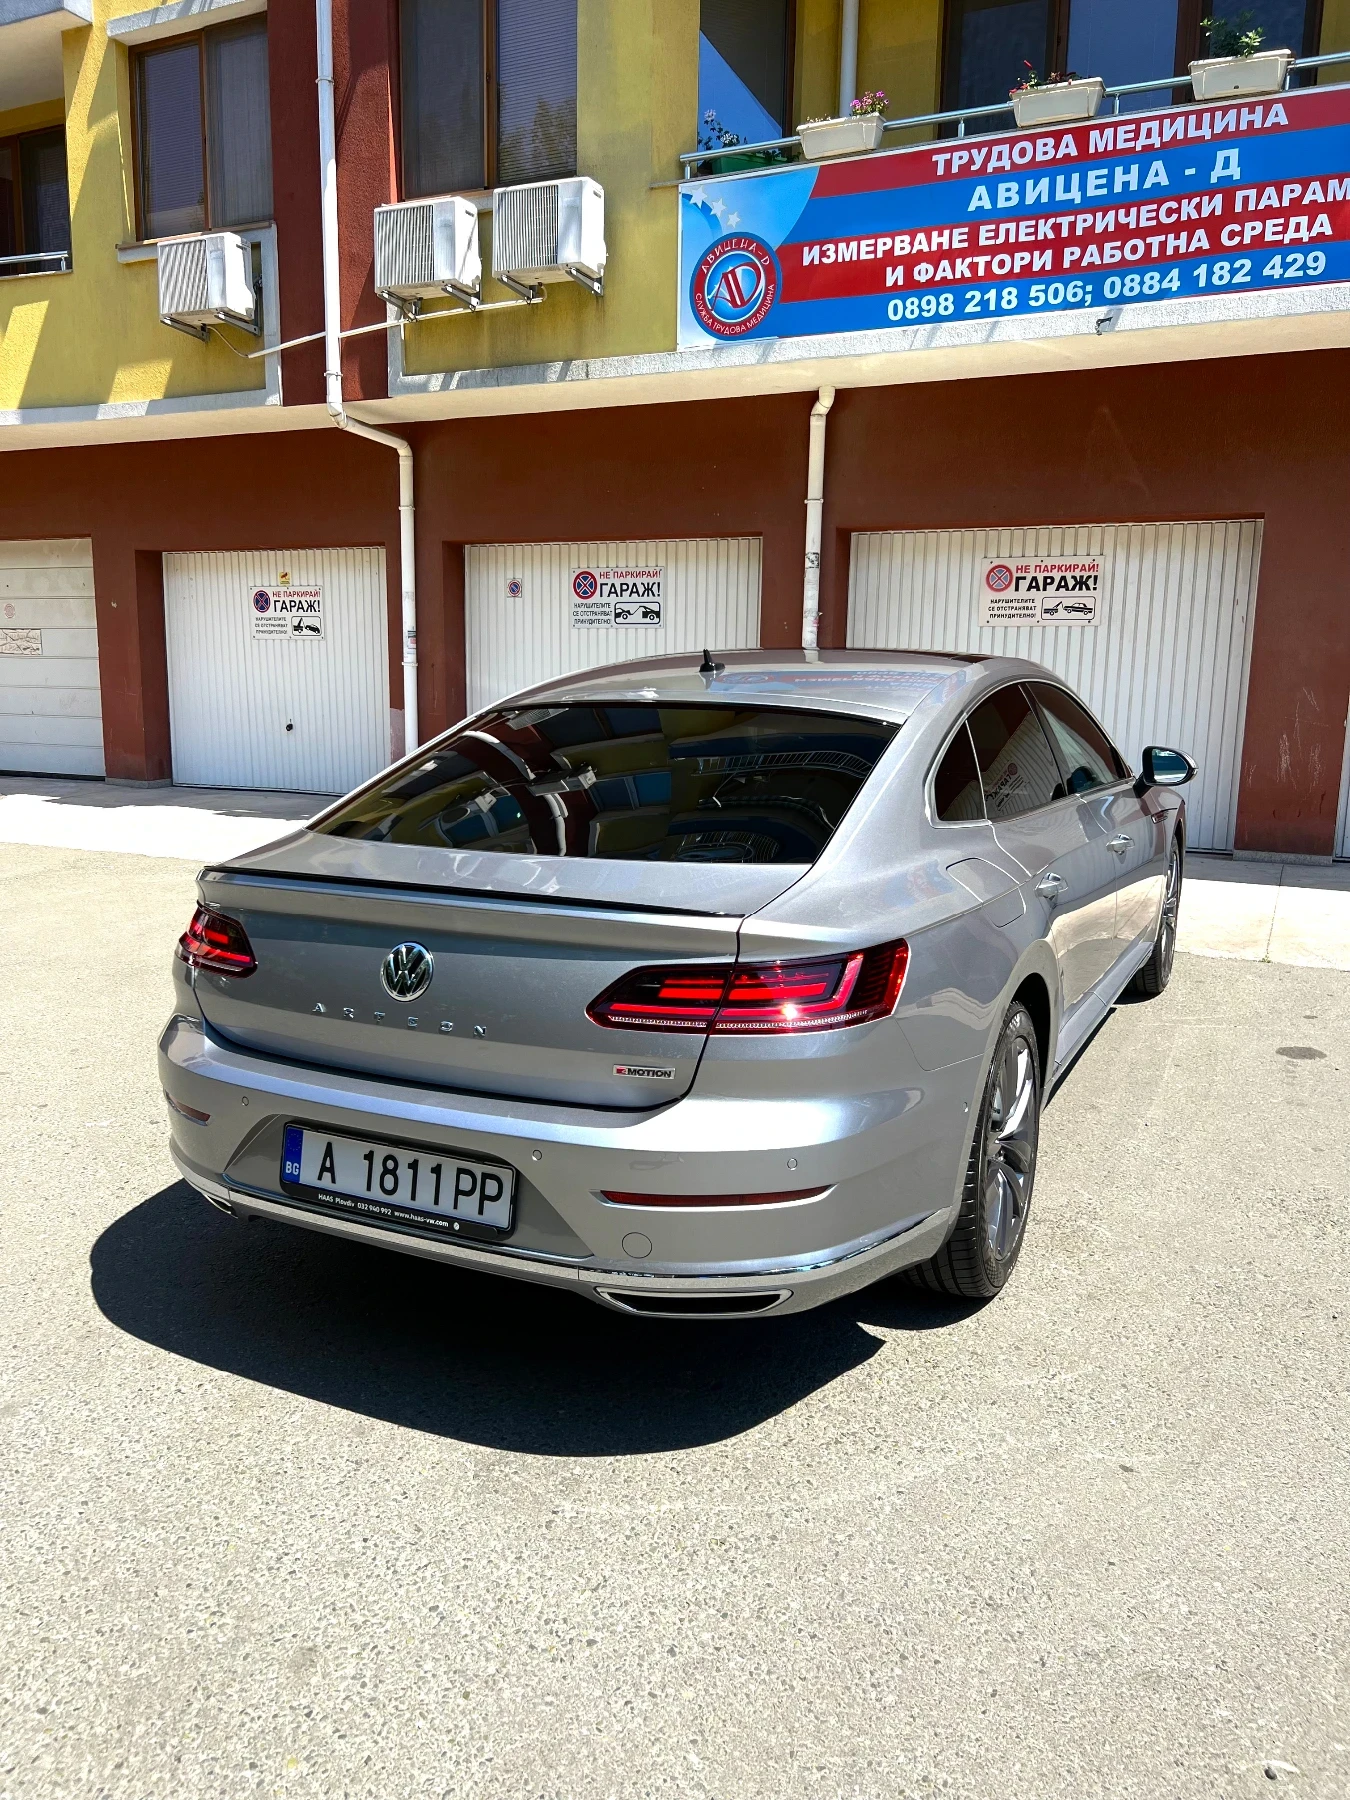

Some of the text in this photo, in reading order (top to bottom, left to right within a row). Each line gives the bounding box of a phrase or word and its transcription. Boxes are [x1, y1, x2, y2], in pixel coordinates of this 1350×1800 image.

[932, 103, 1289, 175] ТРУДОВА МЕДИЦИНА
[967, 160, 1171, 211] АВИЦЕНА
[1210, 148, 1241, 184] Д
[802, 178, 1350, 266] ИЗМЕРВАНЕ ЕЛЕКТРИЧЕСКИ ПАРАМ
[885, 213, 1333, 287] И ФАКТОРИ РАБОТНА СРЕДА
[887, 251, 1327, 321] 0898 218 506; 0884 182 429
[695, 283, 775, 335] СЛУЖБА ТРУДОВА МЕДИЦИНА
[600, 569, 661, 579] НЕ ПАРКИРАЙ!
[1015, 562, 1099, 573] НЕ ПАРКИРАЙ!
[283, 590, 321, 598] ПАРКИРАЙ!
[600, 582, 661, 598] ГАРАЖ!
[1014, 575, 1099, 592] ГАРАЖ!
[273, 599, 321, 612] ГАРАЖ!
[312, 1002, 487, 1038] ARTEON
[285, 1160, 300, 1175] BG
[317, 1142, 336, 1184] A
[318, 1193, 334, 1203] HAAS
[357, 1201, 368, 1210] 032
[381, 1207, 392, 1216] 992
